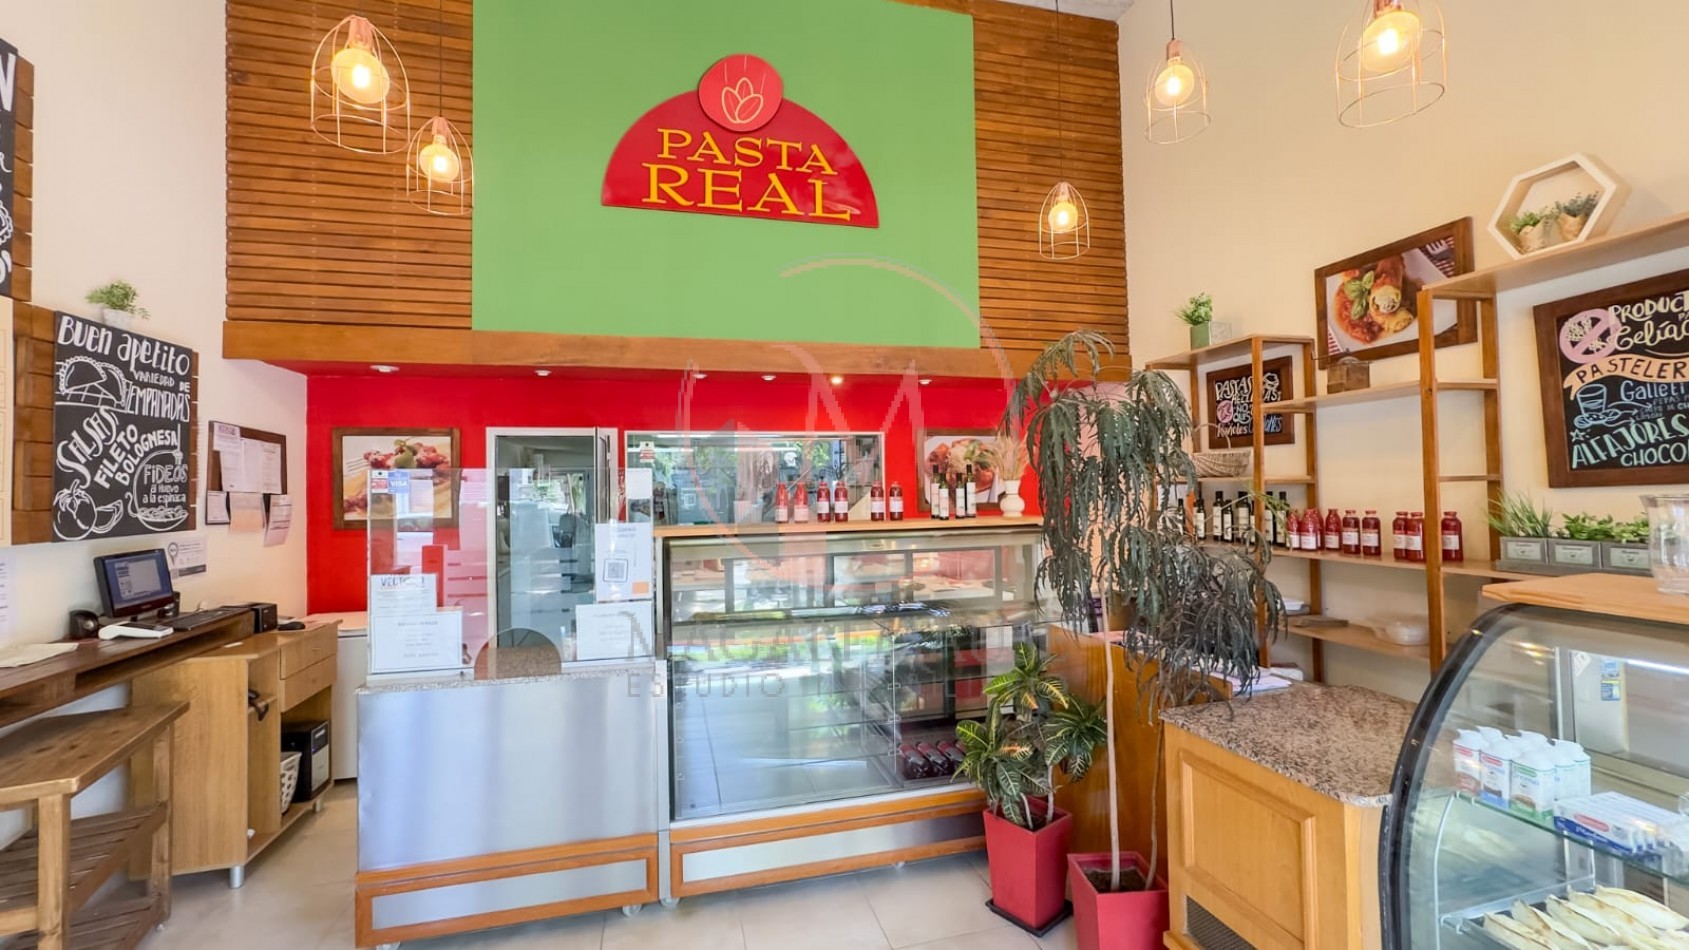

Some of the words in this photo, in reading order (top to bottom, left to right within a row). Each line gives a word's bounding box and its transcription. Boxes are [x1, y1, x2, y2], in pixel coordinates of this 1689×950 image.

[657, 128, 838, 175] PASTA
[641, 162, 851, 221] REAL
[117, 333, 190, 376] apetito
[1576, 357, 1687, 384] PASTELER
[127, 385, 191, 423] EMPANADAS
[132, 370, 175, 387] VARIEDAD
[179, 381, 191, 392] DE
[57, 405, 118, 489] SALSAS
[115, 429, 178, 486] BOLOGNESA
[1572, 413, 1689, 469] ALFAJORES
